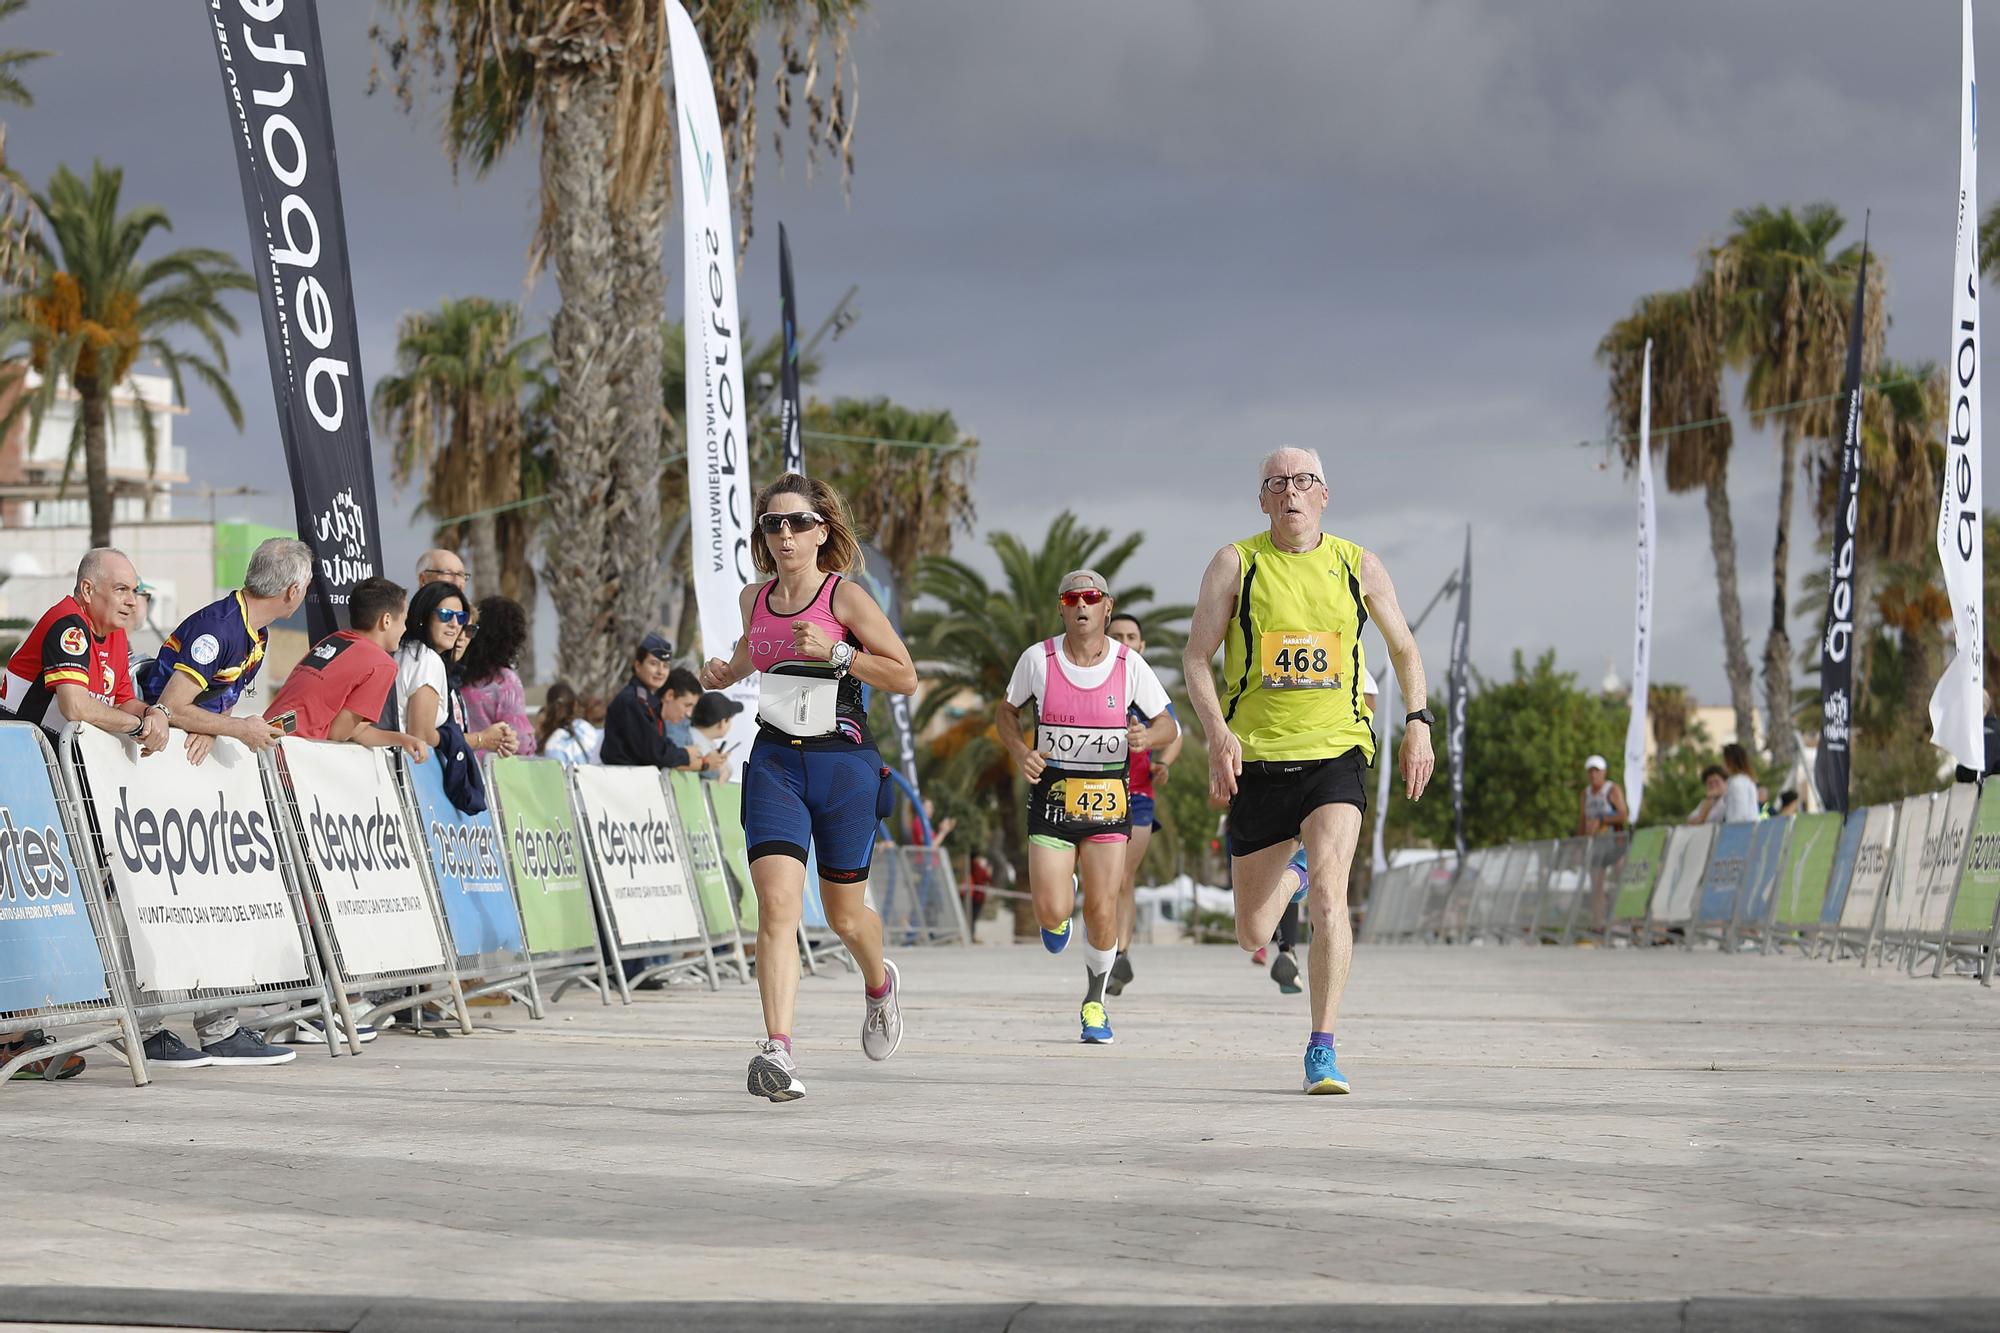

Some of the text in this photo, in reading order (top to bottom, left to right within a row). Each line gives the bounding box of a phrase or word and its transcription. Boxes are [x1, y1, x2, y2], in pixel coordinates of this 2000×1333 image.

[1275, 648, 1328, 672] 468
[1045, 713, 1076, 723] CLUB
[1046, 732, 1120, 758] 30740
[1076, 792, 1117, 811] 423
[115, 787, 275, 896] deportes
[310, 794, 410, 890] deportes
[598, 807, 675, 880] deportes
[193, 905, 209, 924] SAN
[232, 905, 251, 921] DEL
[250, 902, 285, 920] PINATAR
